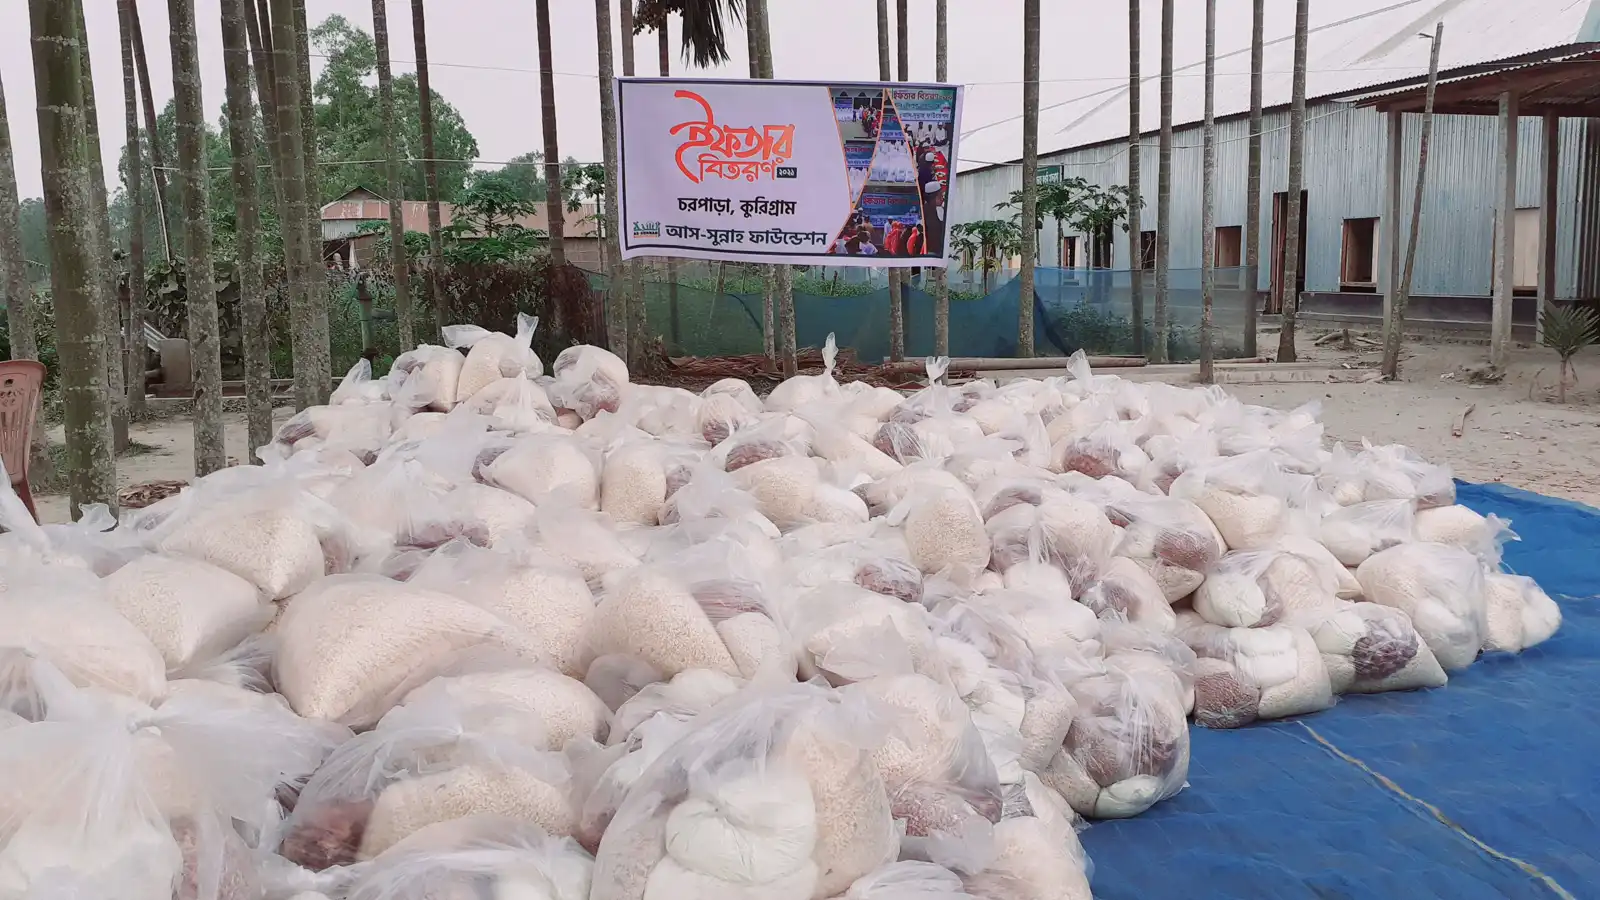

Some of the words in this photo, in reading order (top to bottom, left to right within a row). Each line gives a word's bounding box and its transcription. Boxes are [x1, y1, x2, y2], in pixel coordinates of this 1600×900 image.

[669, 89, 796, 184] ইফতার
[697, 153, 777, 182] বিতরণ
[778, 168, 796, 177] ২০২১
[677, 196, 735, 216] চরপাড়া,
[739, 195, 797, 218] কুরিগ্রাম
[665, 225, 745, 246] আস-সুন্নাহ
[748, 228, 828, 246] ফাউন্ডেশন
